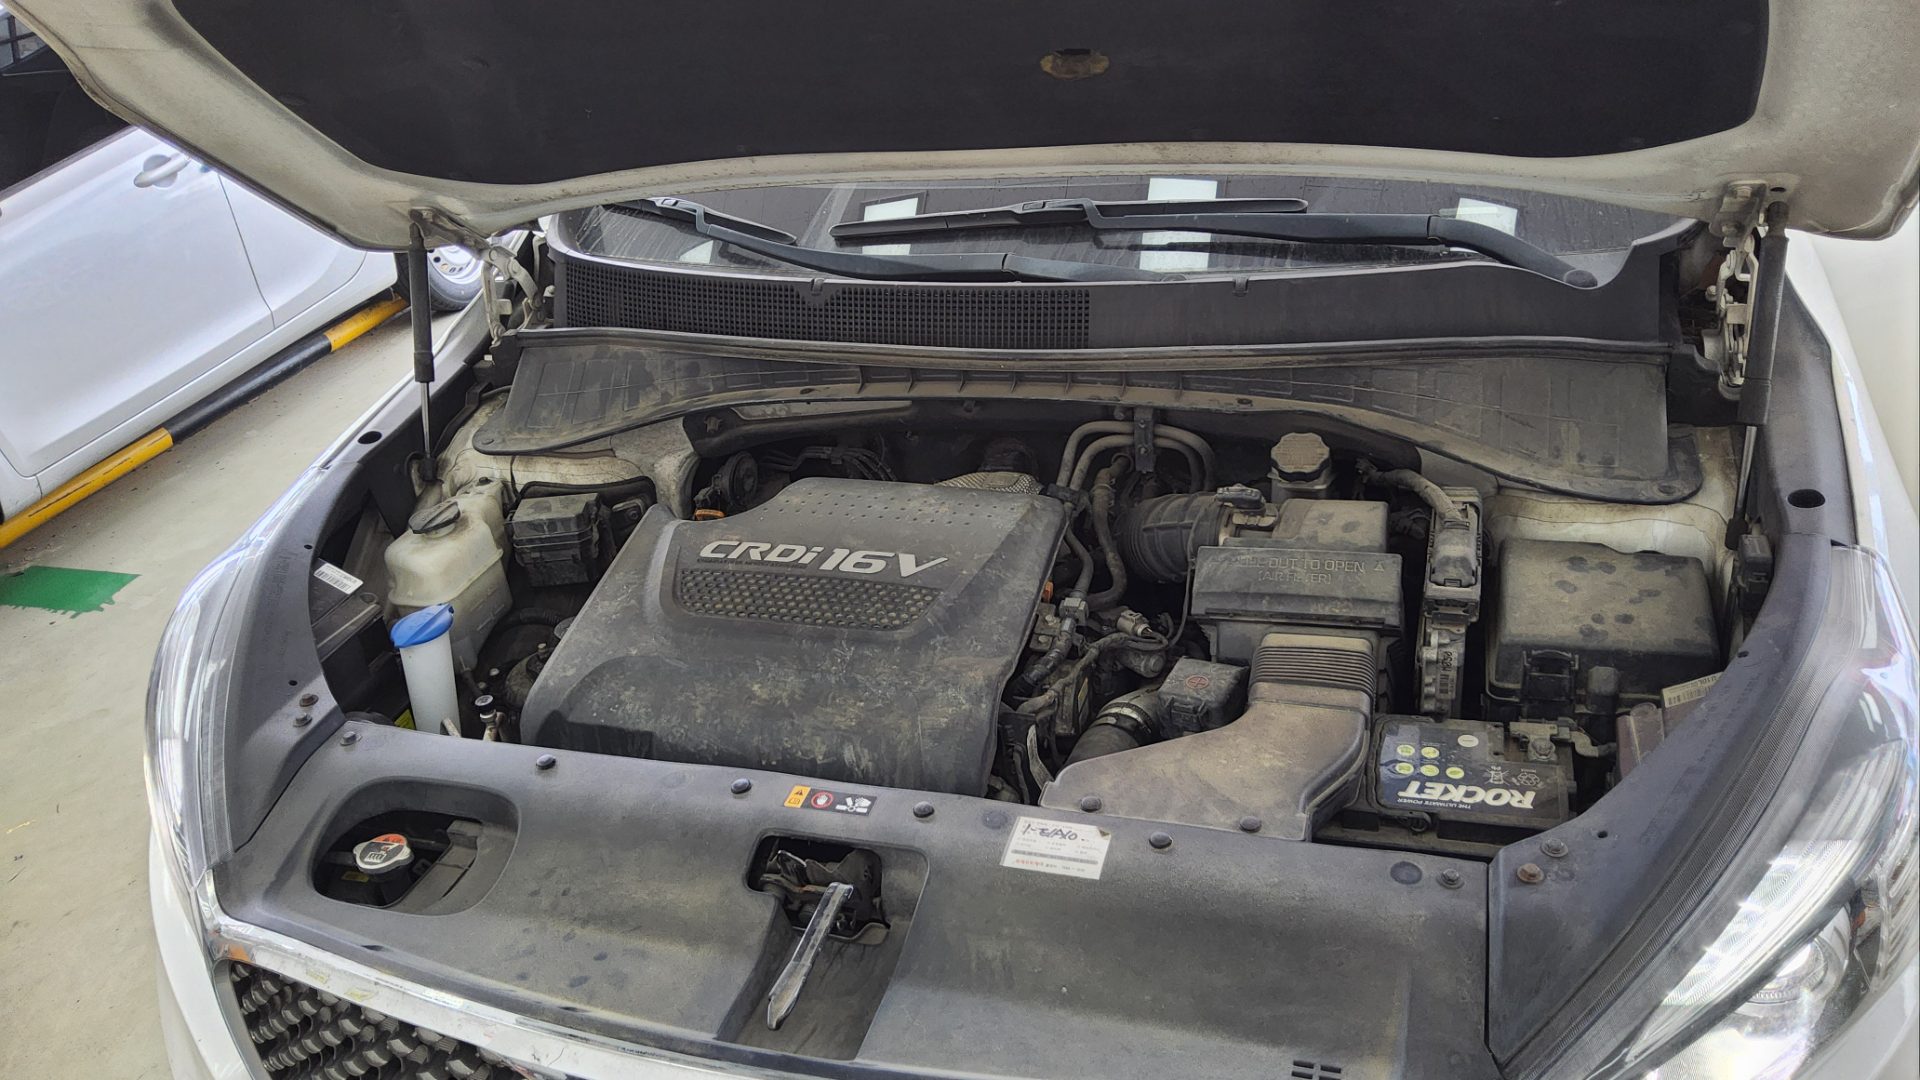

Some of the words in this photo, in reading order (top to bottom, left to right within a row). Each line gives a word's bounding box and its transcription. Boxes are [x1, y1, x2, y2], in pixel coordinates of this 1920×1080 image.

[700, 540, 825, 564] CRDi
[818, 547, 948, 577] 16V
[1268, 557, 1299, 570] OUT
[1302, 558, 1321, 571] TO
[1324, 559, 1366, 574] OPEN
[1397, 780, 1537, 809] ROCKET
